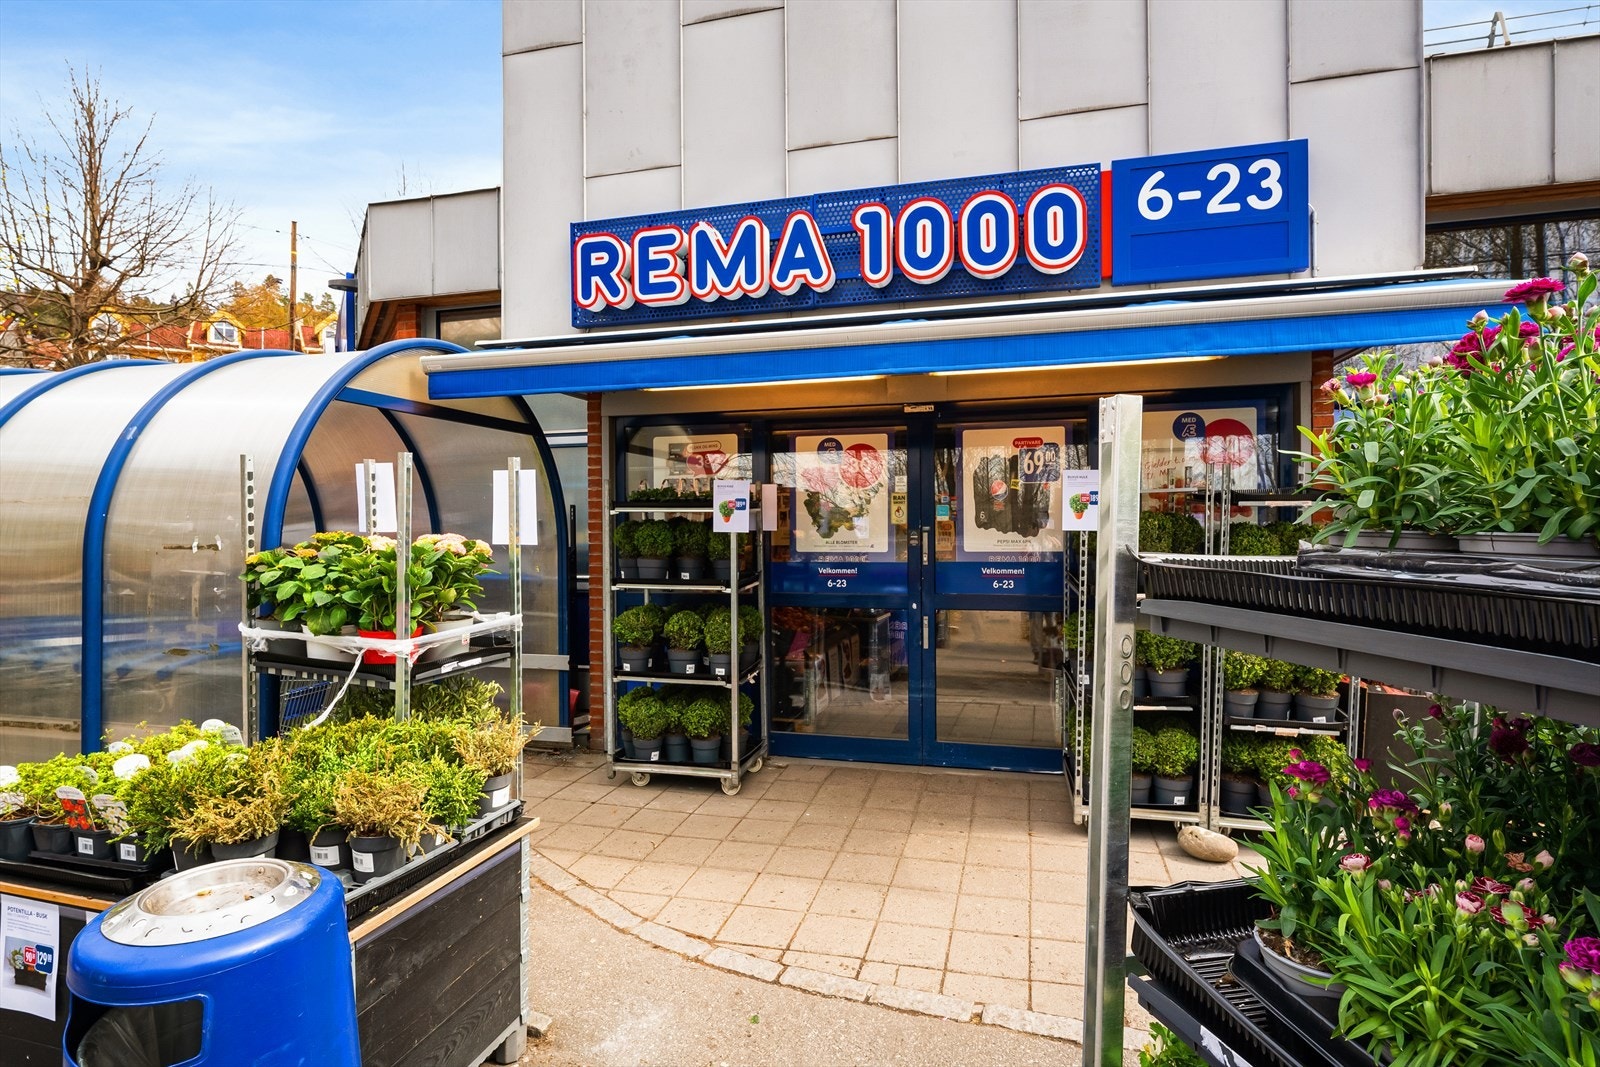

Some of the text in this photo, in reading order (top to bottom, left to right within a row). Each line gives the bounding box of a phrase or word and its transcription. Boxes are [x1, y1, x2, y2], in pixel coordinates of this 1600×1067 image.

[1137, 158, 1284, 221] 6-23
[573, 183, 1089, 312] REMA 1000
[981, 567, 1025, 575] Velkommen!
[827, 579, 847, 588] 6-23
[992, 580, 1014, 588] 6-23
[7, 906, 33, 916] POTENTILLA
